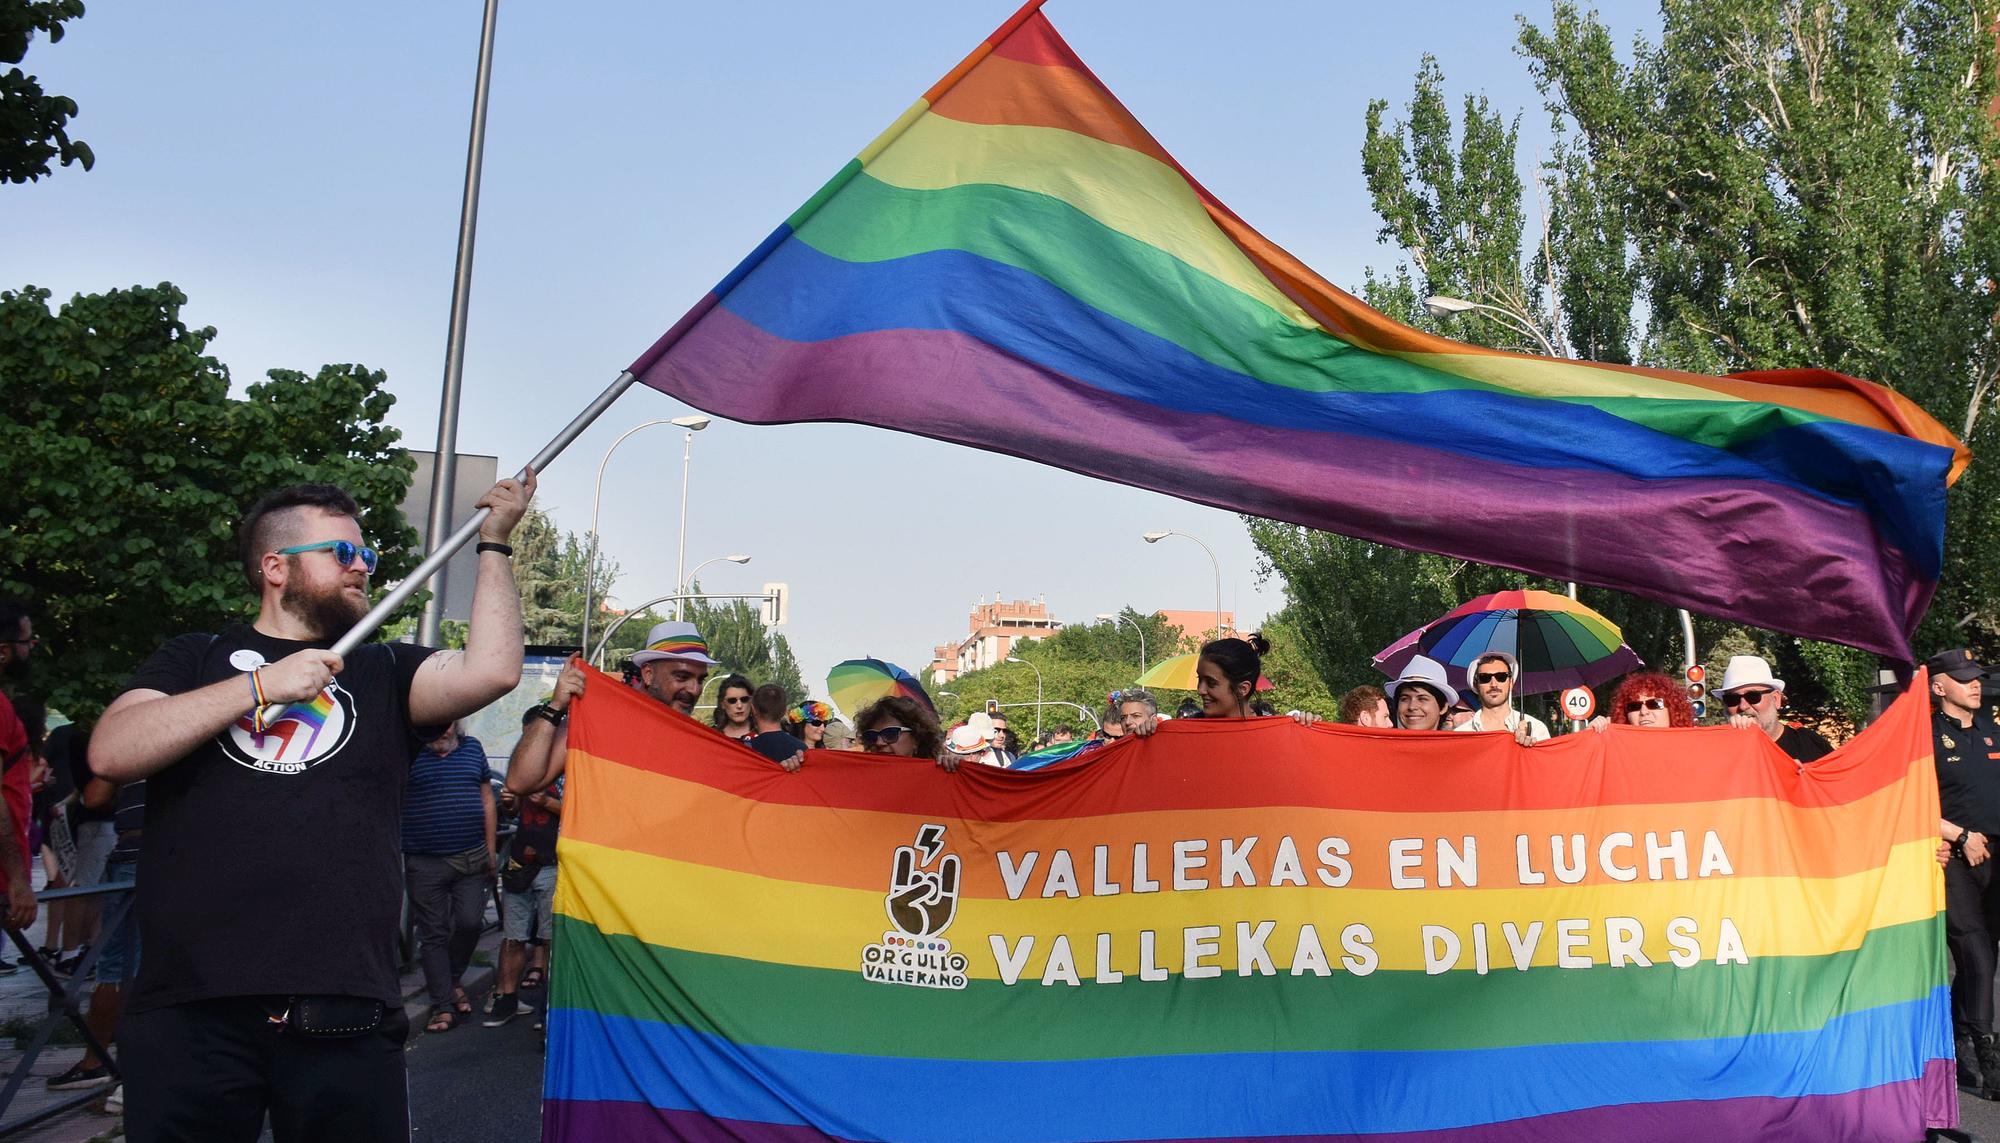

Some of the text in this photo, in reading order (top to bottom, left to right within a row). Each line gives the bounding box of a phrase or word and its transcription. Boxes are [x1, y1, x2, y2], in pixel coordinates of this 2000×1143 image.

[1569, 696, 1587, 707] 40
[253, 760, 307, 772] ACTION
[996, 830, 1735, 900] VALLEKAS EN LUCHA
[865, 947, 965, 971] ORGULLO
[988, 916, 1750, 986] VALLEKAS DIVERSA
[866, 964, 964, 987] VALLEKANO
